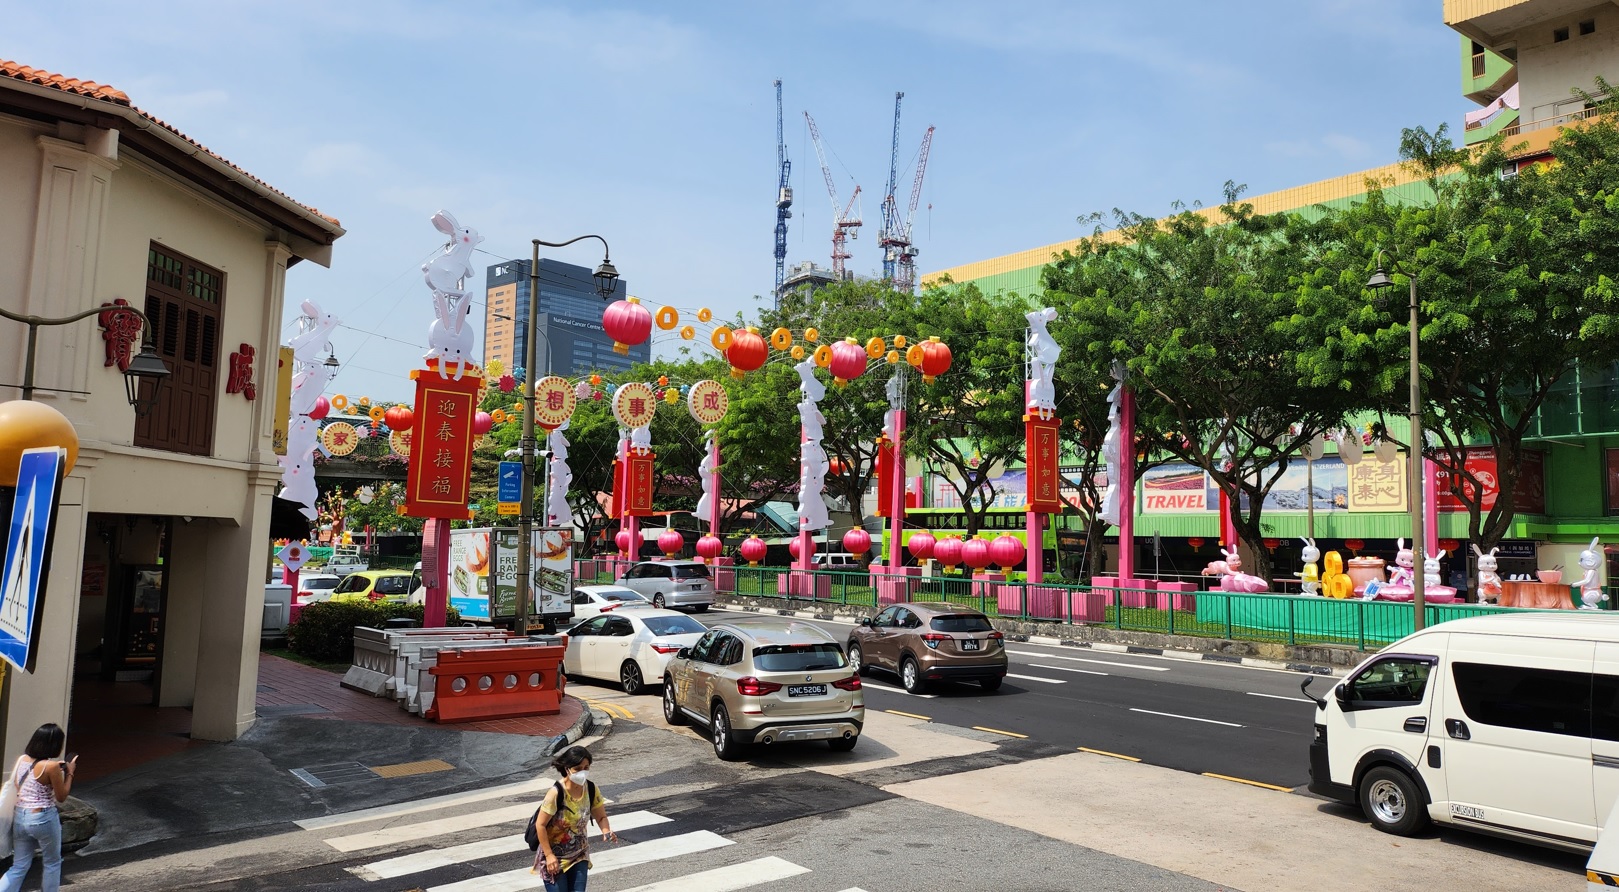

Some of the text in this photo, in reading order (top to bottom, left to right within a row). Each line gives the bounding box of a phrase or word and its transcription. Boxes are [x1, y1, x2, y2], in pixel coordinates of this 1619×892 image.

[553, 317, 571, 325] National
[571, 320, 586, 328] Cancer
[587, 323, 601, 331] Centre
[545, 389, 565, 411] 想
[628, 397, 646, 417] 事
[703, 391, 720, 411] 成
[333, 431, 349, 446] 家
[431, 399, 456, 494] 迎春接福
[1041, 433, 1051, 496] 万事如意
[638, 464, 646, 506] 万事如意
[1146, 495, 1205, 509] TRAVEL
[453, 554, 464, 562] EGGS
[500, 556, 517, 565] FRE
[1450, 803, 1485, 819] EXCURSION BUS
